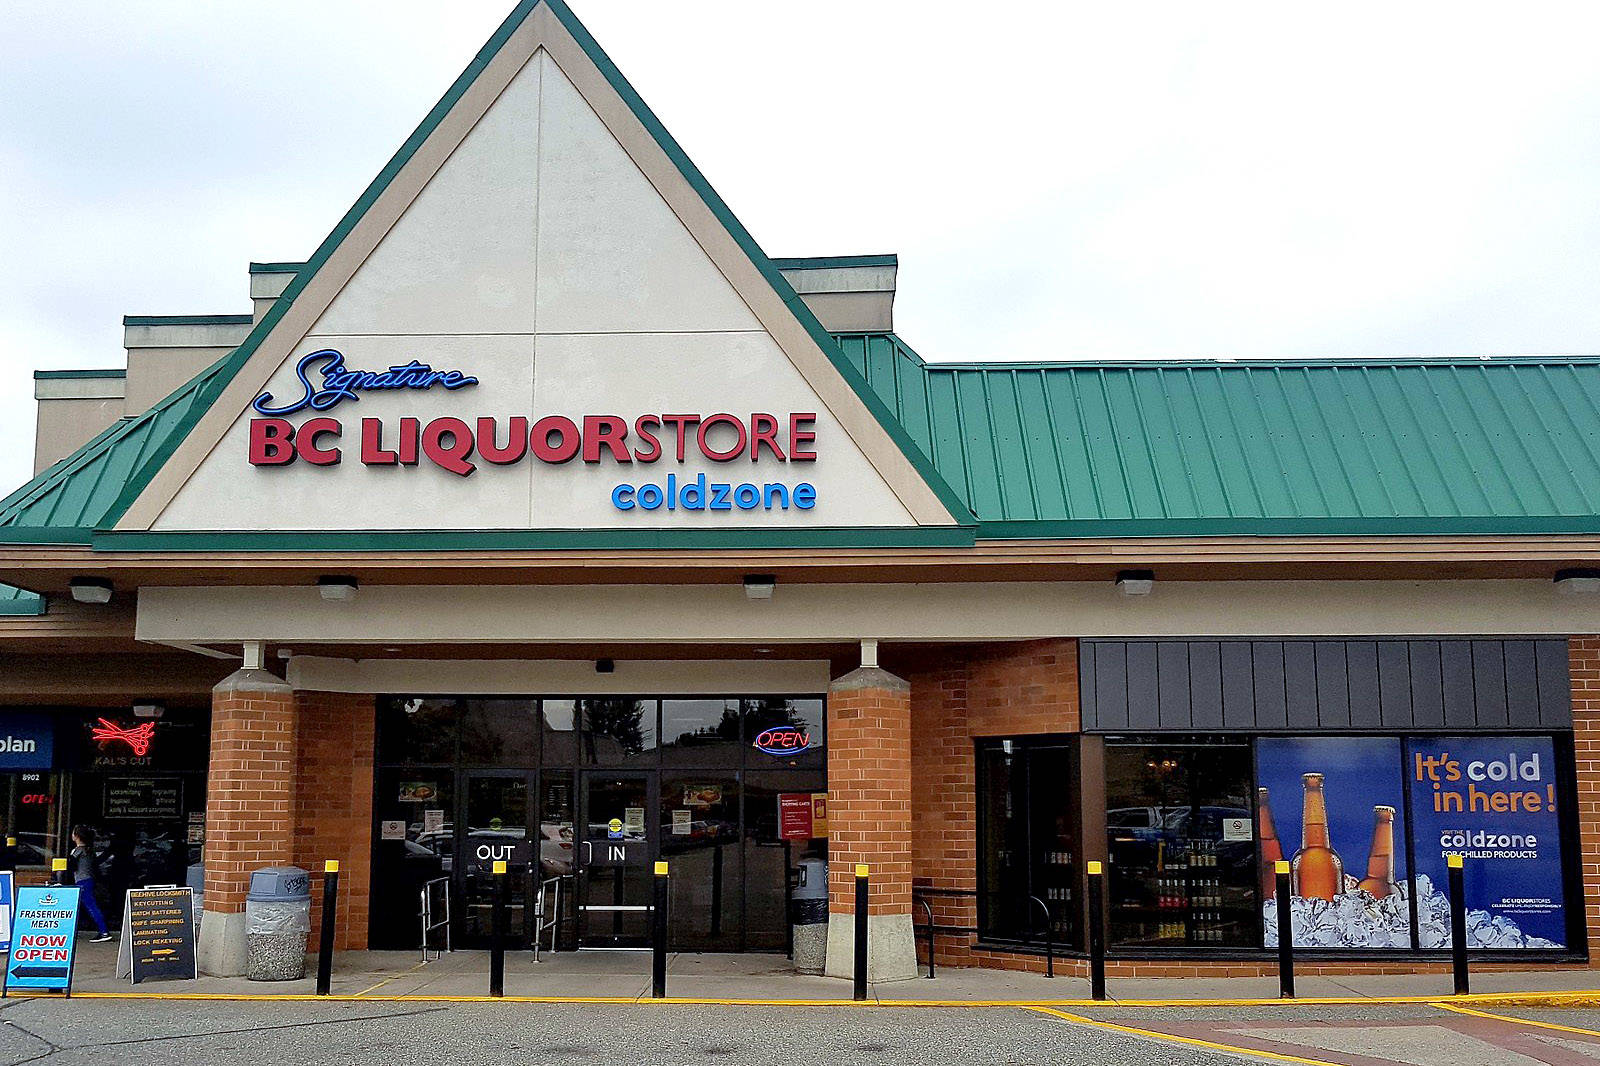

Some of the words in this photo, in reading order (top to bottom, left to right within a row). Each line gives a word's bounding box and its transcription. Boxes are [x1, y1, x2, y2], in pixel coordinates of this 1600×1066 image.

[253, 348, 479, 416] Signature
[249, 417, 342, 466] BC
[611, 473, 817, 511] coldzone
[757, 732, 810, 748] OPEN
[1415, 752, 1462, 781] It's
[1467, 753, 1541, 781] cold
[1433, 782, 1463, 812] in
[1440, 830, 1537, 848] coldzone
[476, 845, 515, 860] OUT
[608, 846, 626, 862] IN
[20, 910, 73, 919] FRASERVIEW
[31, 920, 59, 928] MEATS
[20, 935, 67, 947] NOW
[14, 949, 68, 961] OPEN
